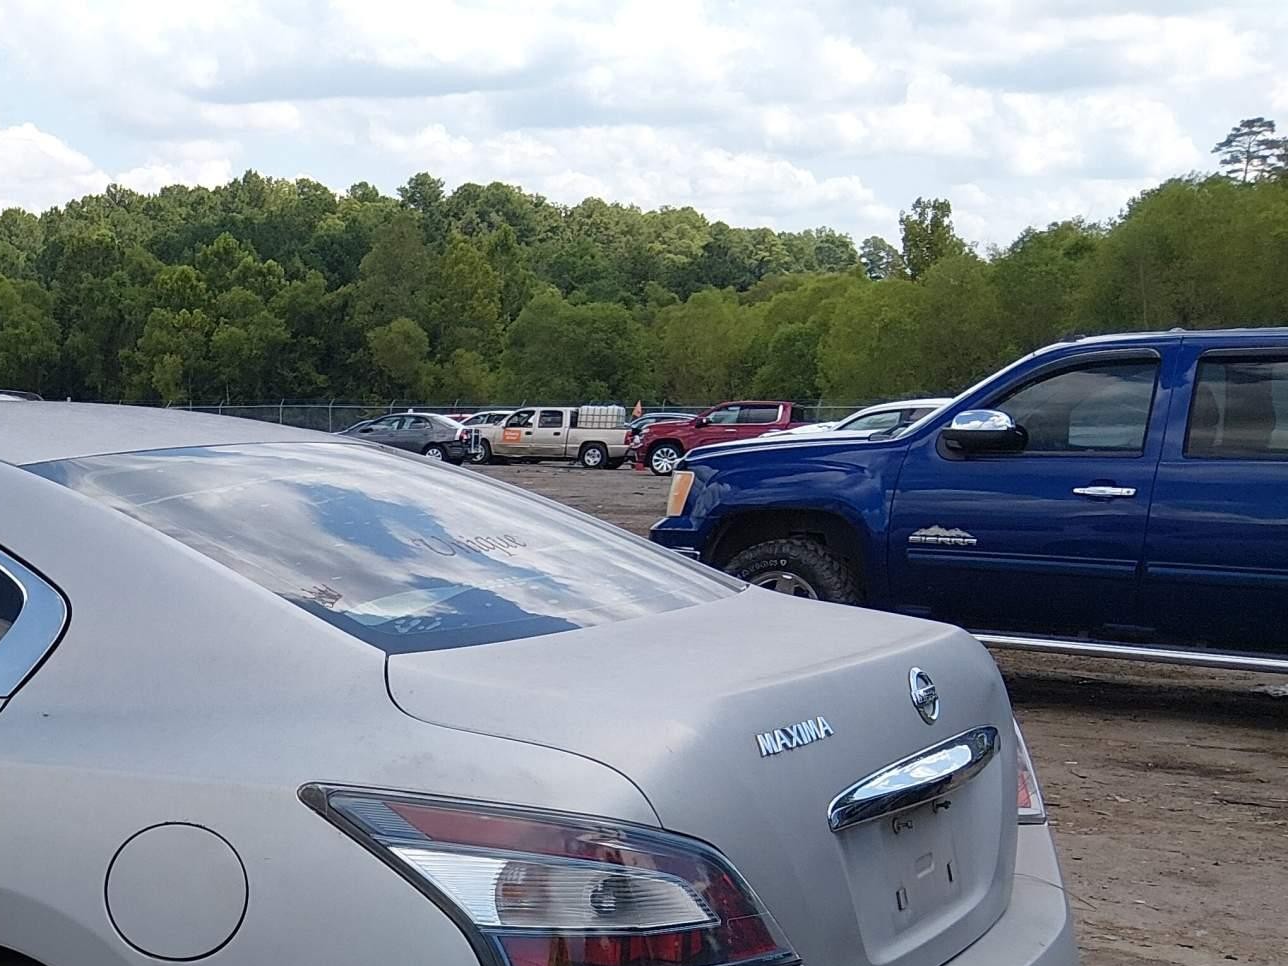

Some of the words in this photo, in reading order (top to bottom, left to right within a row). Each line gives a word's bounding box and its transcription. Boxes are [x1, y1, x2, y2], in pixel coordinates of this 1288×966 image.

[411, 534, 527, 556] Unique
[908, 536, 977, 546] SIERRA
[757, 716, 834, 757] MAXIMA
